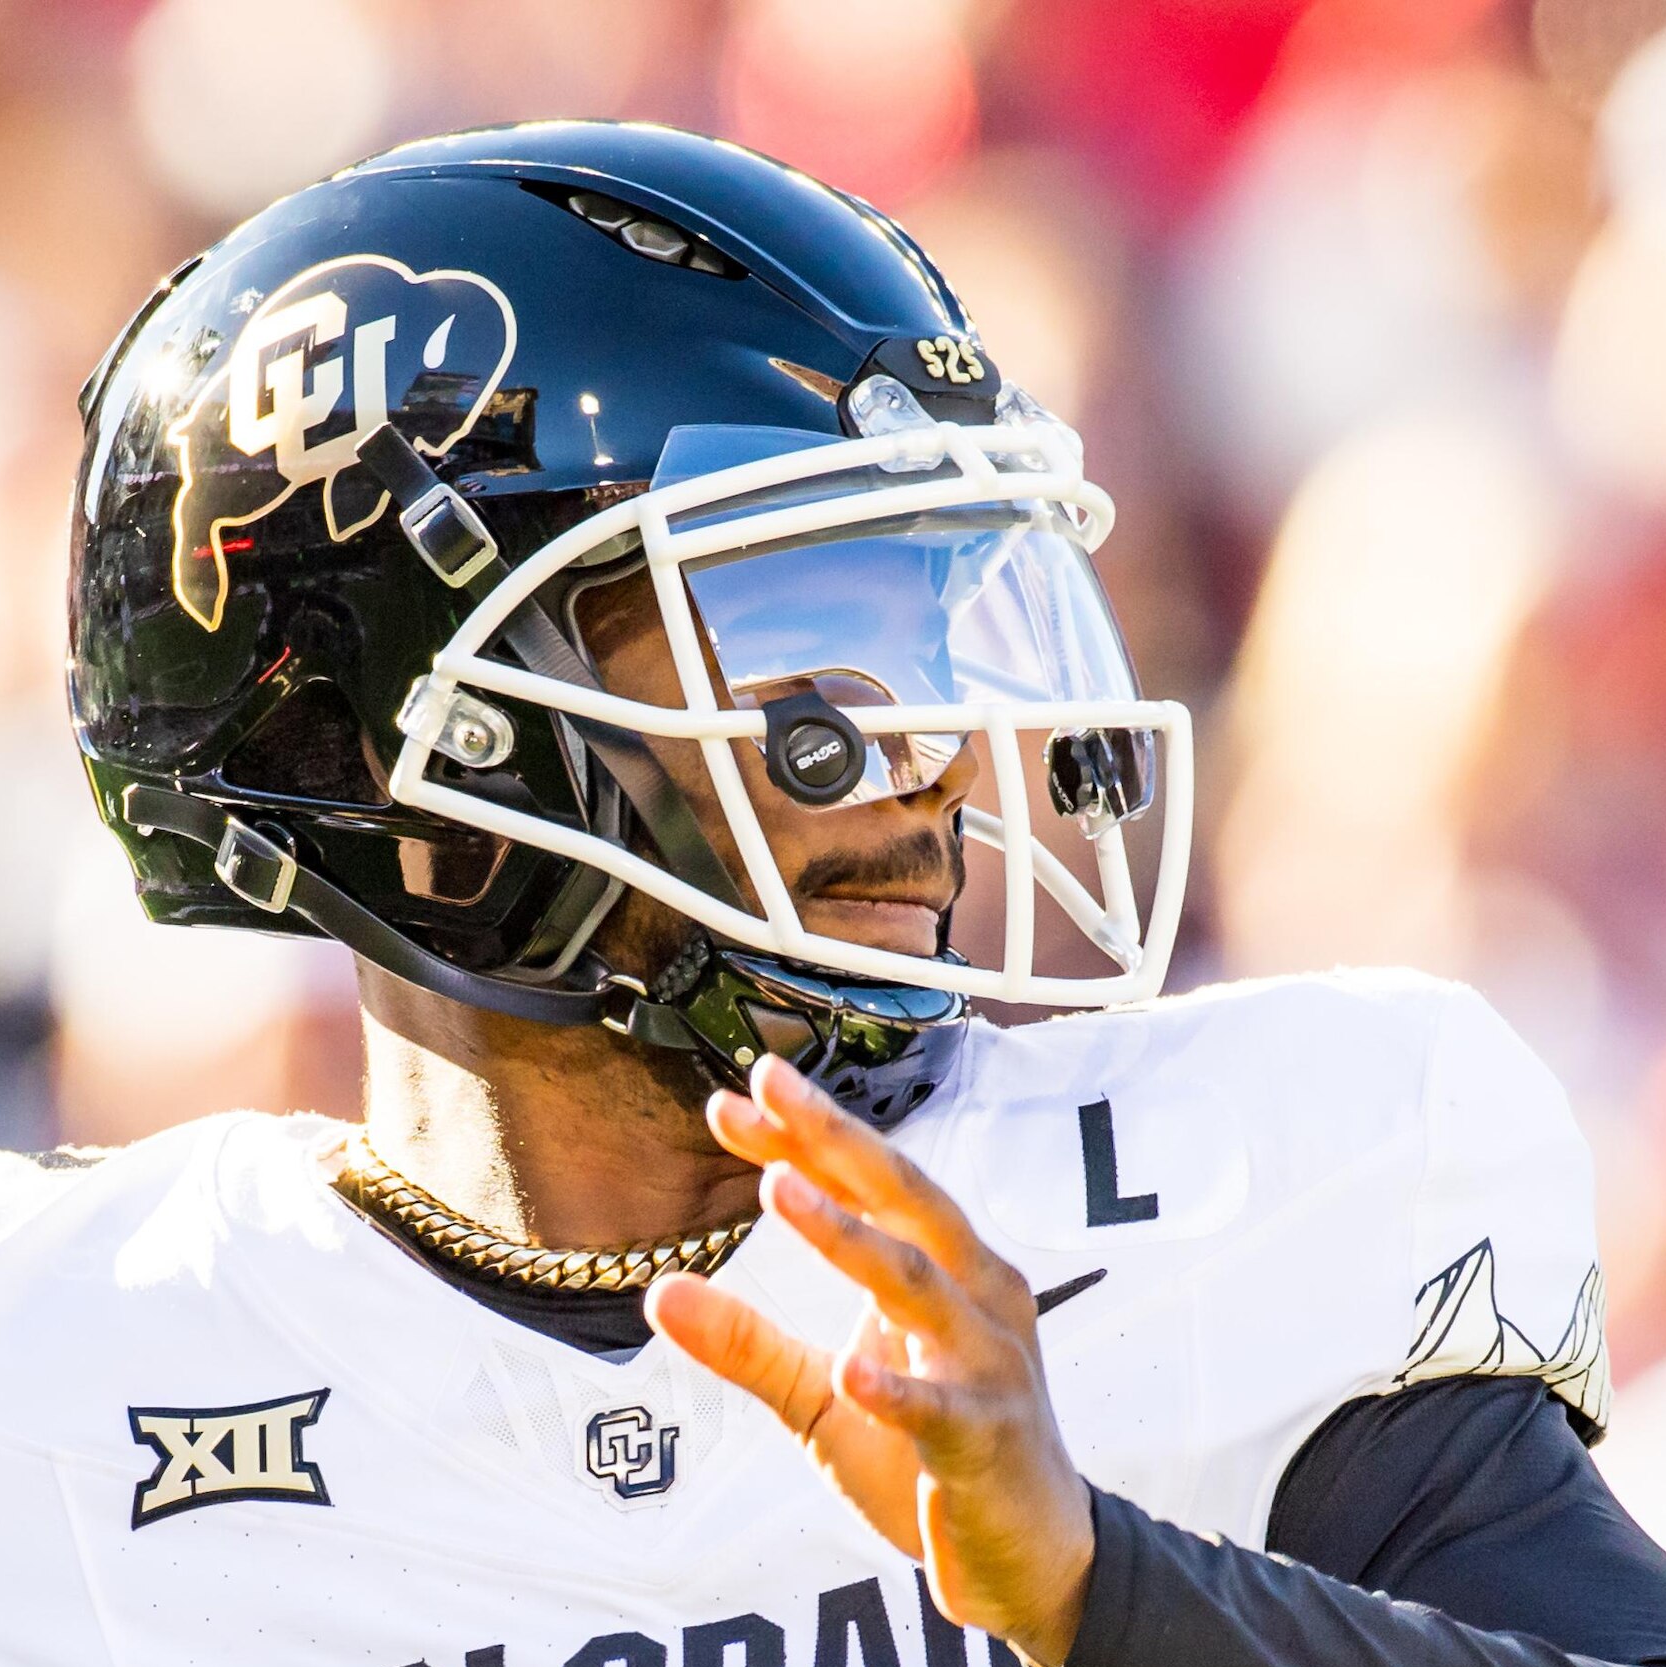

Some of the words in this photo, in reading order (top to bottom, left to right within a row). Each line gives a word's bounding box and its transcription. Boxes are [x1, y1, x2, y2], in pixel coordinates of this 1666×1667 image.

[229, 290, 397, 482] CU
[796, 741, 841, 770] SHOC
[1078, 1099, 1159, 1228] L
[135, 1395, 323, 1514] XII
[587, 1405, 679, 1499] CU
